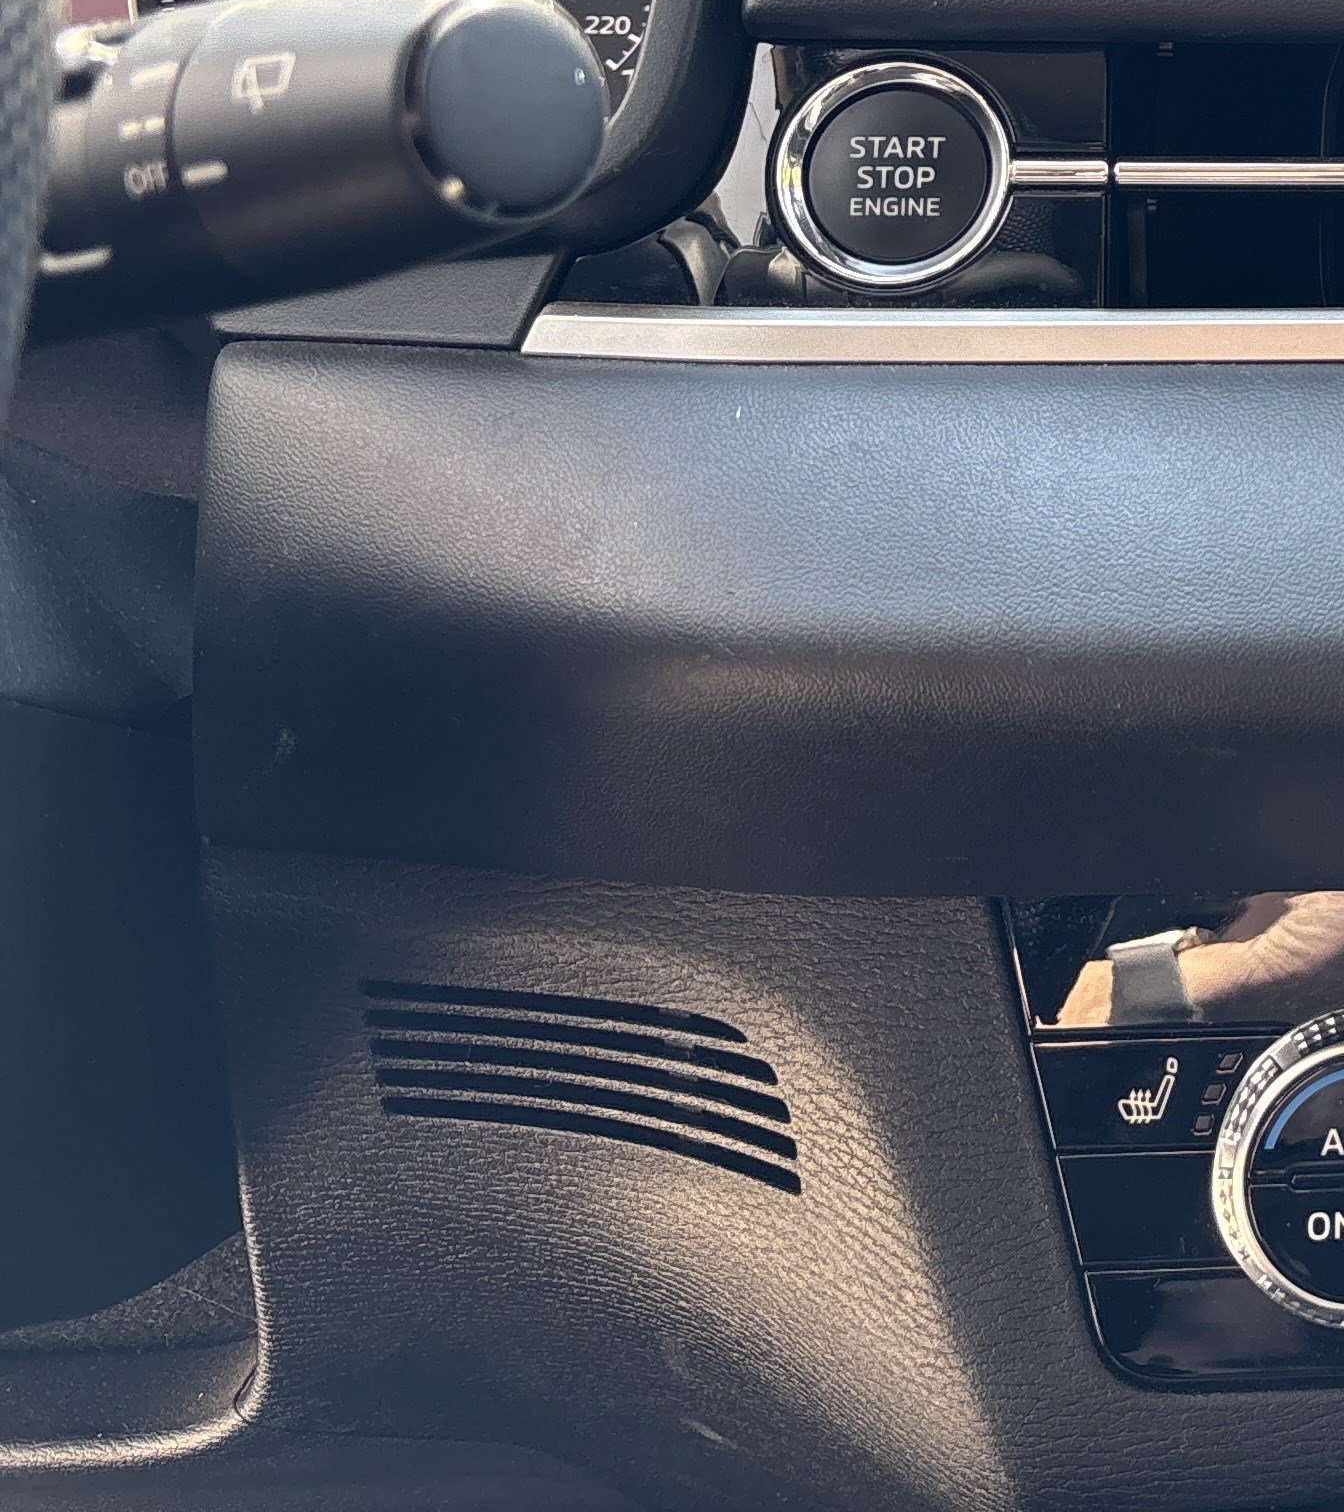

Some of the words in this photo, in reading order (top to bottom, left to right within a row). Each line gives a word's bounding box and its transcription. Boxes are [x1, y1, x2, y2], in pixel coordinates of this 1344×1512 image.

[584, 15, 631, 35] 220
[850, 136, 946, 159] START
[857, 165, 936, 189] STOP
[849, 196, 941, 217] ENGINE
